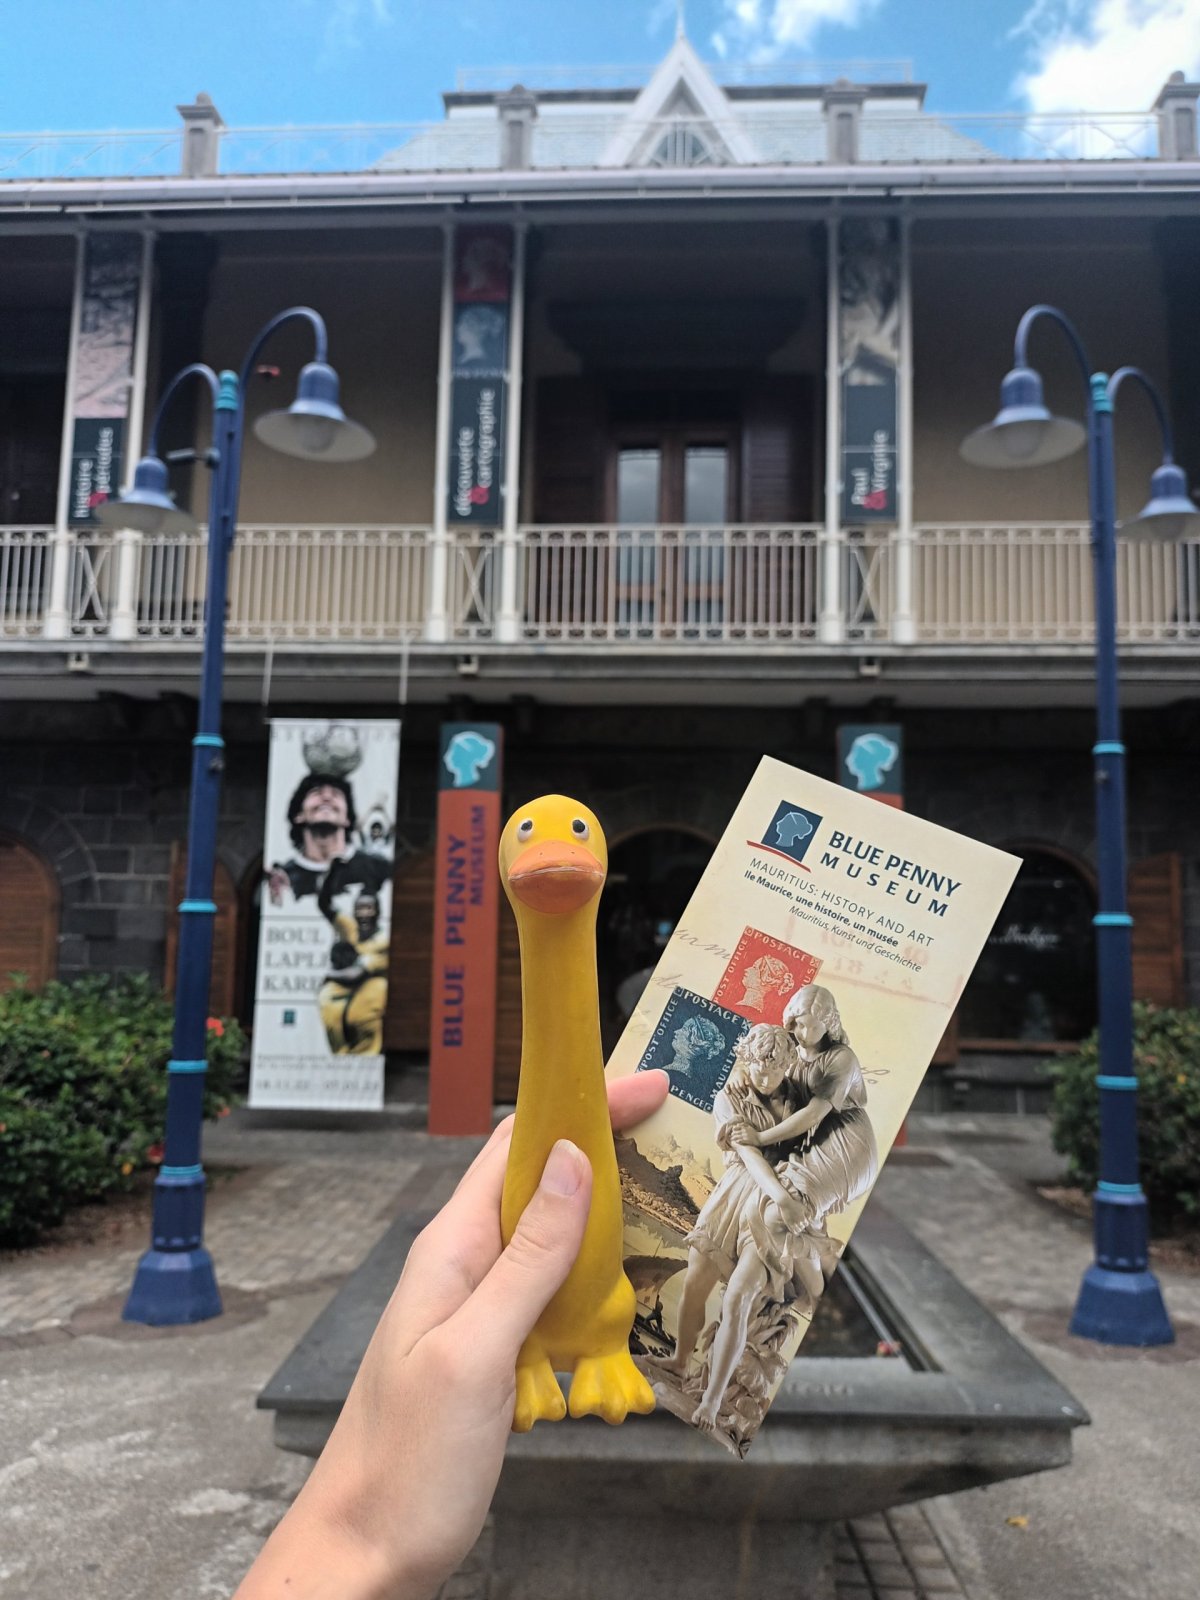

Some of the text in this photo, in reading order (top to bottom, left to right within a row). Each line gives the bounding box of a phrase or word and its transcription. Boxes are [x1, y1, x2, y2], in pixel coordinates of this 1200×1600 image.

[454, 427, 475, 516] découverte
[477, 388, 496, 488] cartographie
[871, 429, 892, 493] Virginie
[851, 467, 869, 505] Paul
[470, 806, 485, 905] MUSEUM
[820, 853, 949, 918] MUSEUM
[829, 831, 962, 899] BLUE PENNY
[749, 858, 935, 948] MAURITIUS: HISTORY AND ART
[755, 875, 794, 901] Maurice,
[795, 894, 814, 910] une
[814, 901, 851, 927] histoire,
[853, 921, 866, 932] un
[866, 927, 899, 948] musée
[443, 834, 466, 1047] BLUE PENNY
[728, 939, 749, 974] OFFICE
[754, 932, 810, 962] POSTAGE
[789, 905, 830, 932] Mauritius,
[831, 925, 857, 943] Kunst
[855, 935, 874, 951] und
[874, 945, 922, 973] Geschichte
[641, 1038, 659, 1070] POST
[657, 998, 678, 1036] OFFICE
[684, 990, 740, 1024] POSTAGE
[670, 1084, 706, 1109] PENCE
